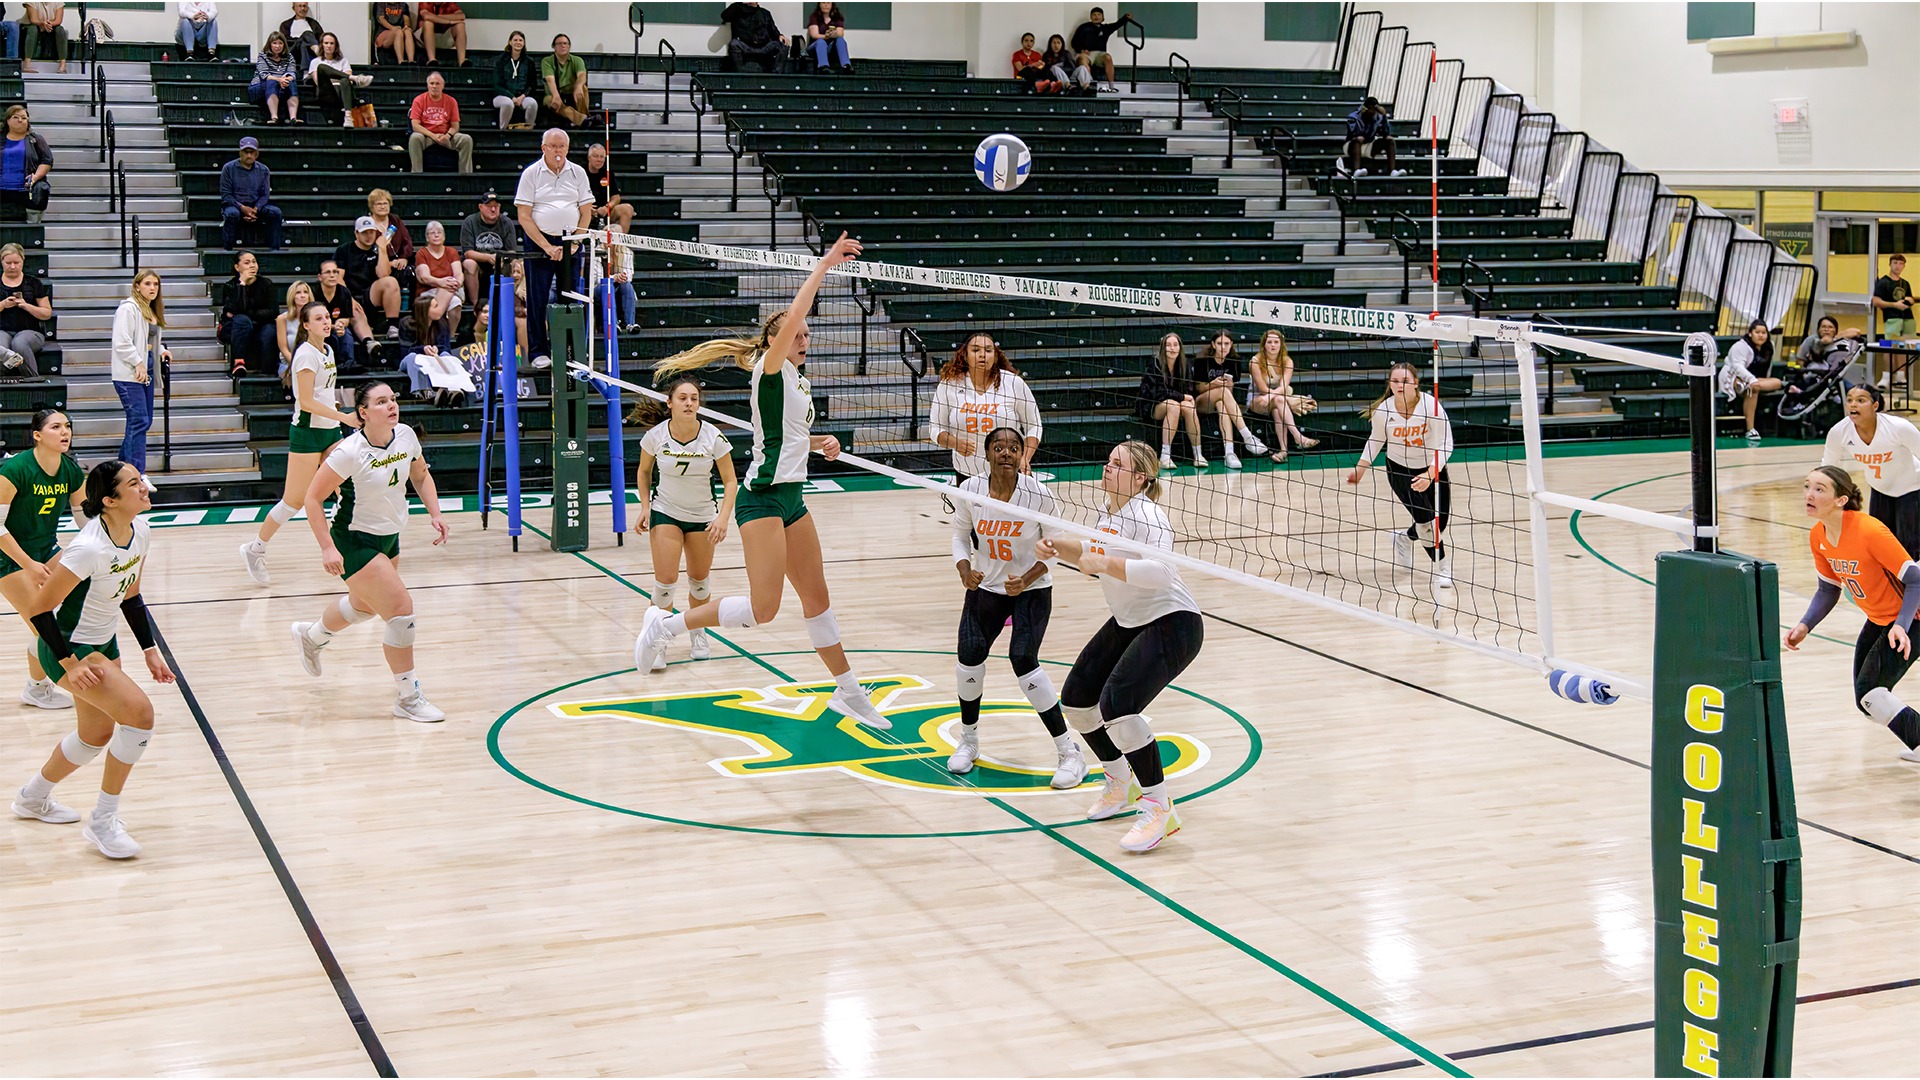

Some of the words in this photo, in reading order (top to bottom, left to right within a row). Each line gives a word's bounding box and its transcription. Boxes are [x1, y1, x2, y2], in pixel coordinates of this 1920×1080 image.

[772, 252, 802, 267] YAVAPAI
[878, 264, 915, 280] YAVAPAI
[934, 270, 991, 289] ROUGHRIDERS
[1015, 278, 1060, 297] YAVAPAI
[1087, 285, 1162, 307] ROUGHRIDERS
[1195, 295, 1256, 318] YAVAPAI
[1294, 304, 1396, 331] ROUGHRIDERS
[965, 417, 994, 434] 22
[674, 461, 691, 476] 7
[1868, 464, 1882, 480] 7
[388, 468, 400, 488] 4
[38, 497, 57, 515] 2
[986, 538, 1013, 562] 16
[1827, 558, 1860, 576] UAZ
[1681, 684, 1726, 1078] COLLEGE
